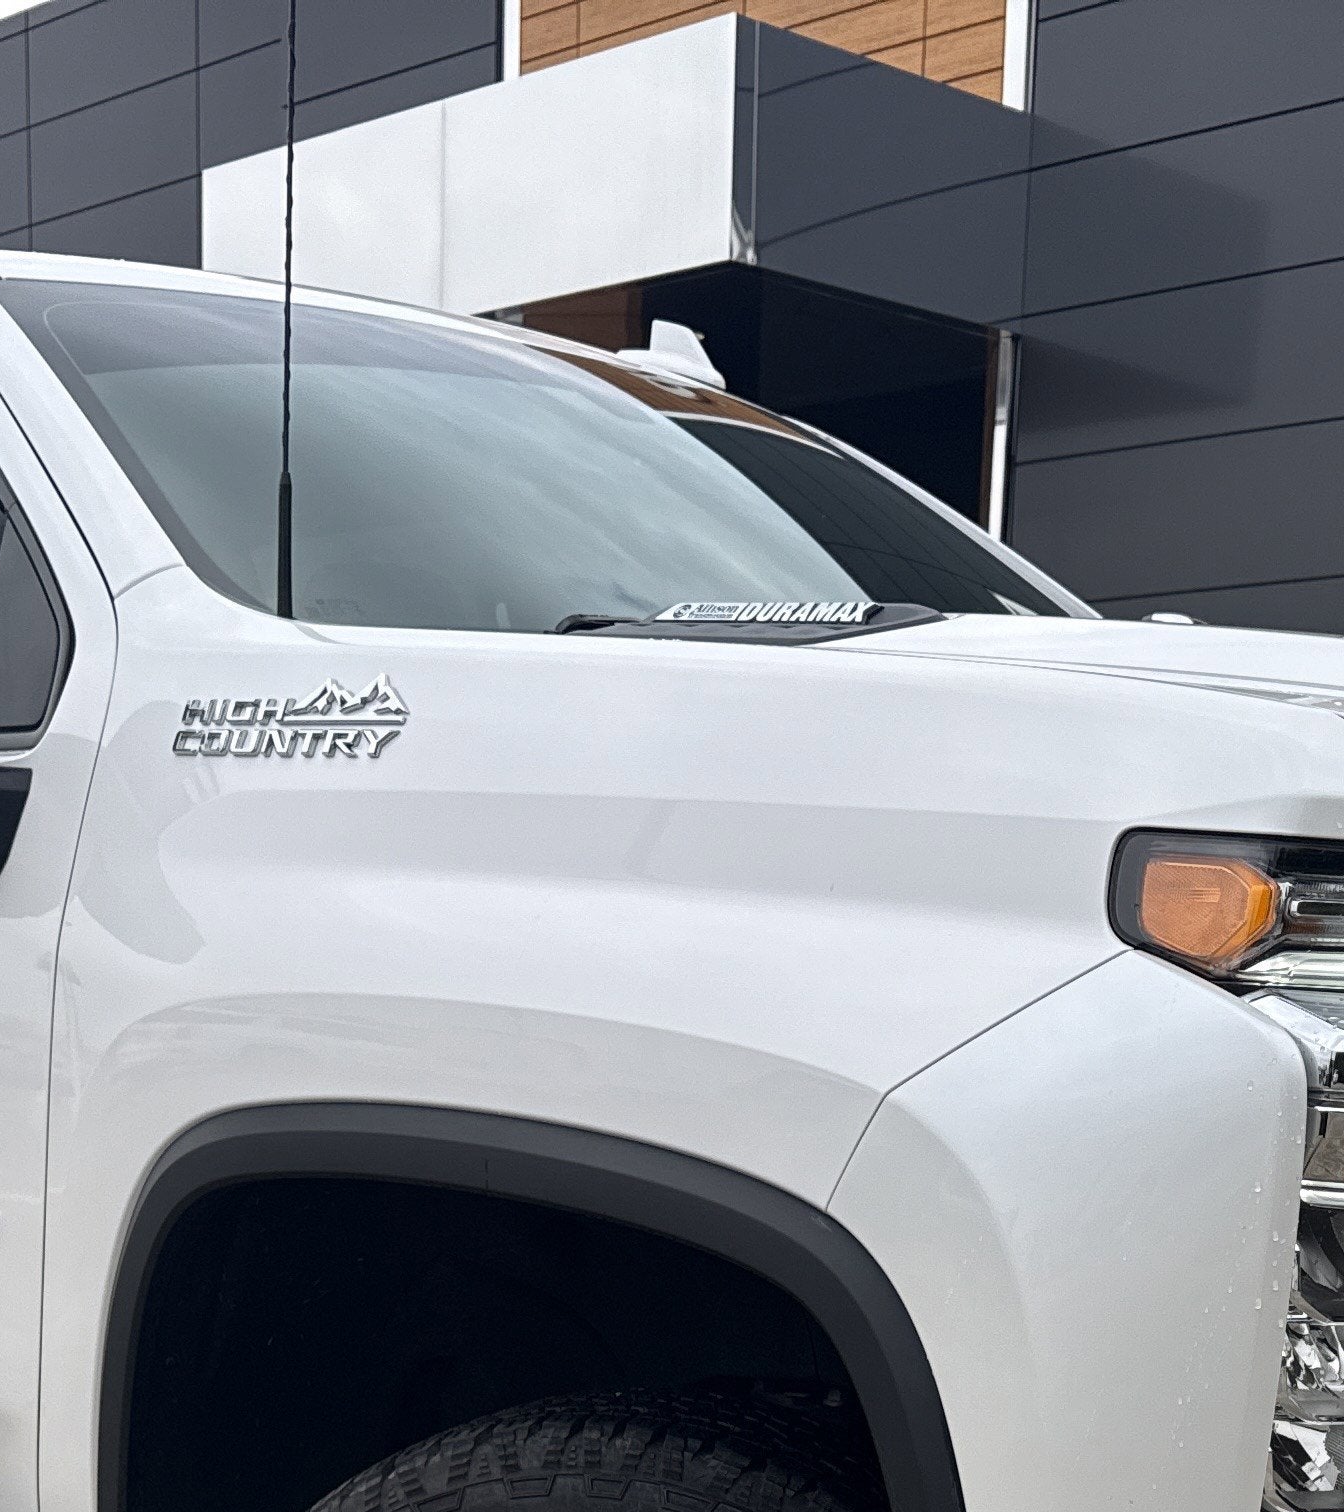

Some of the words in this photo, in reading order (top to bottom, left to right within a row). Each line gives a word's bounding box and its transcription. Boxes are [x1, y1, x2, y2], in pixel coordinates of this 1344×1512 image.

[737, 602, 877, 623] DURAMAX
[181, 698, 297, 726] HIGH
[172, 729, 401, 758] COUNTRY
